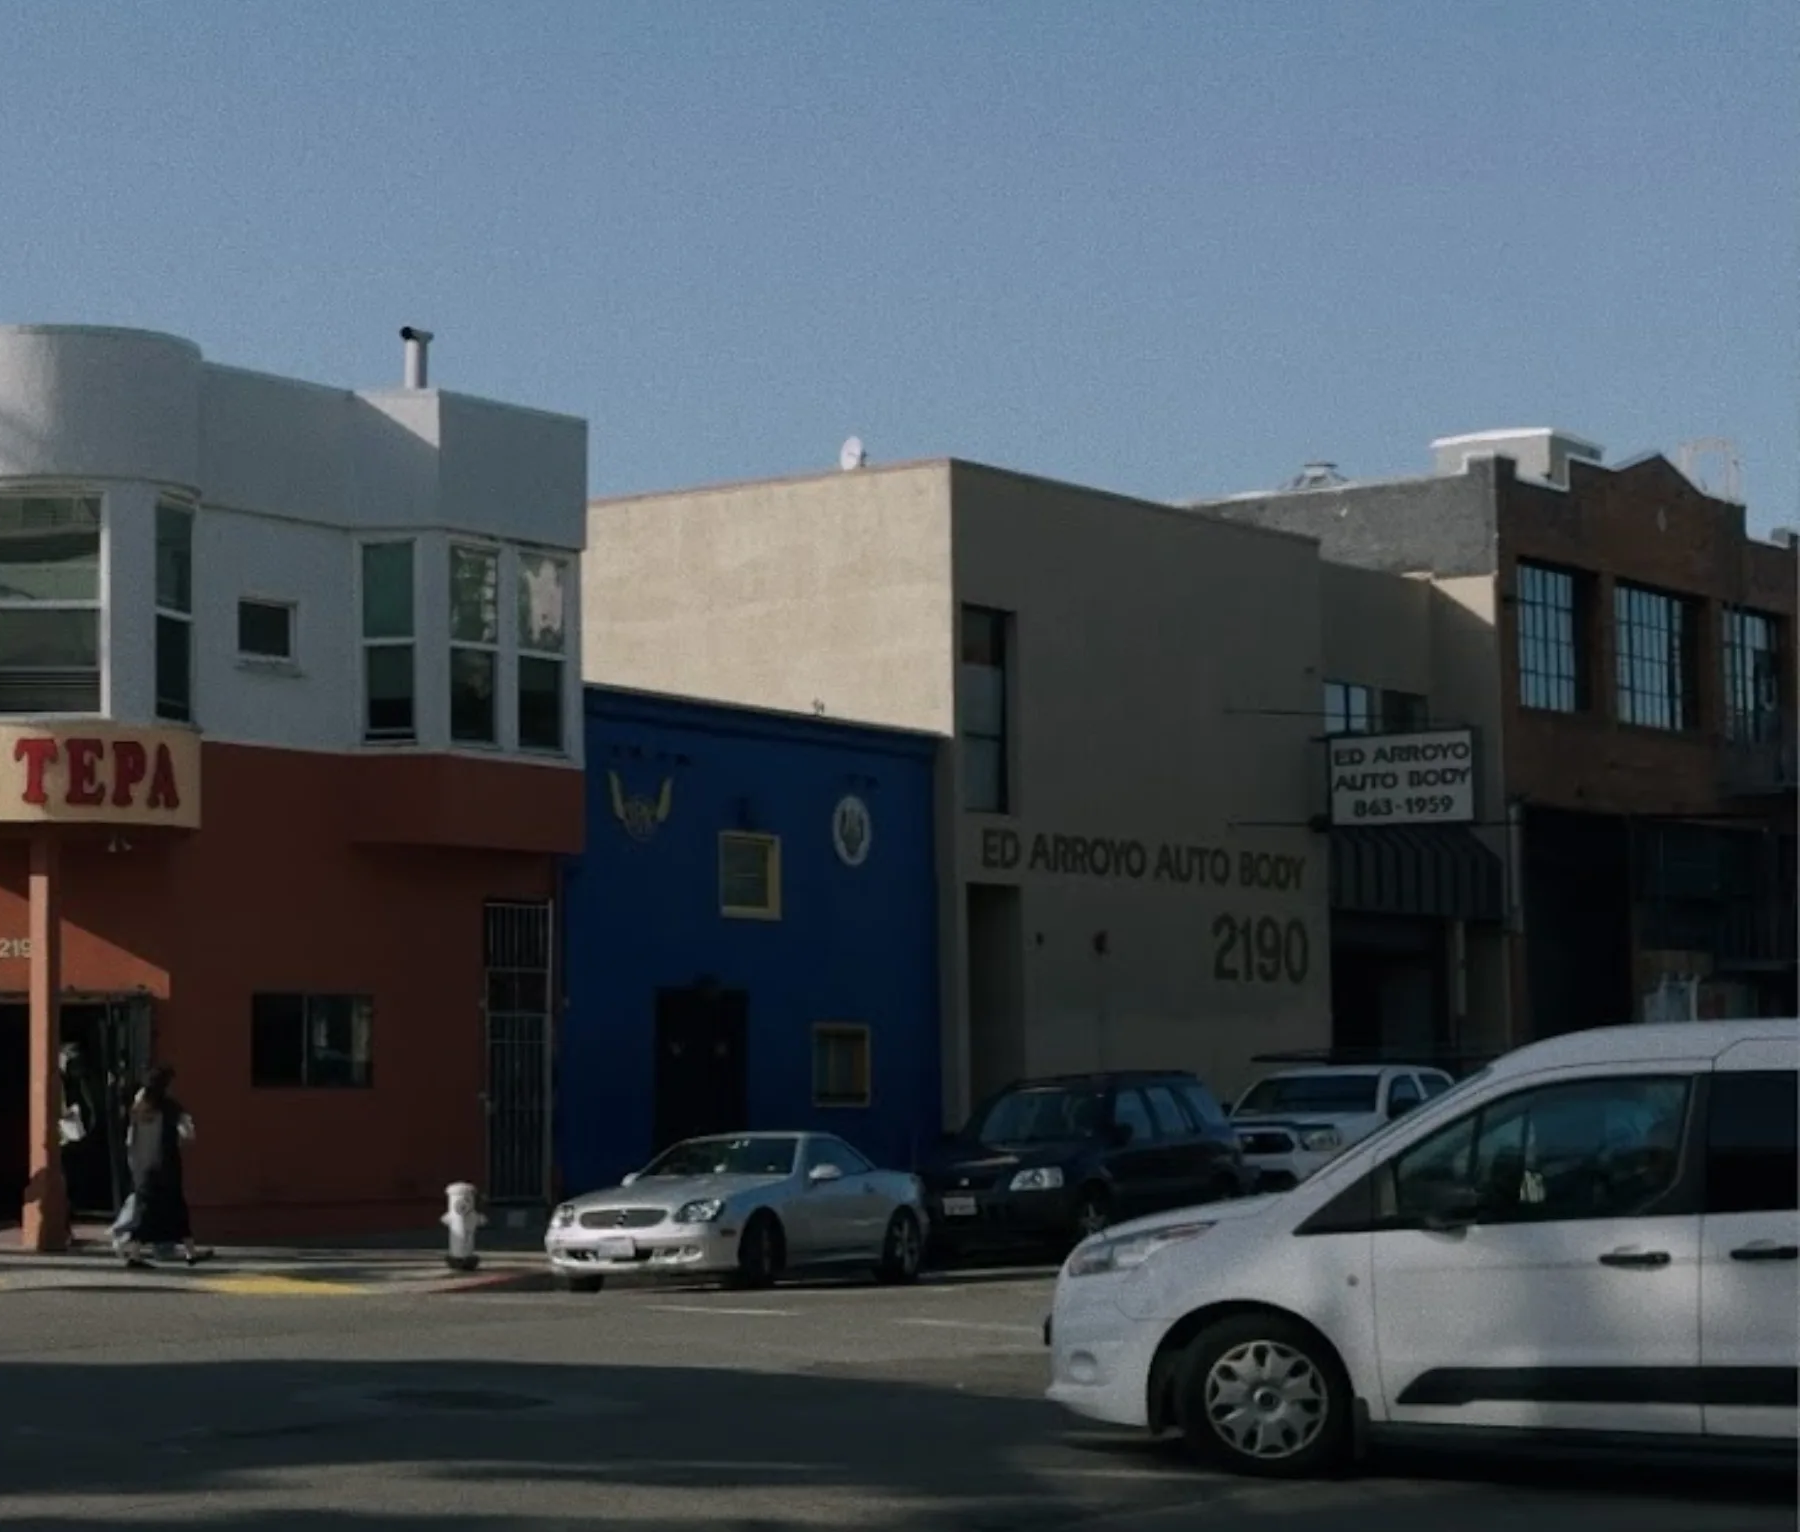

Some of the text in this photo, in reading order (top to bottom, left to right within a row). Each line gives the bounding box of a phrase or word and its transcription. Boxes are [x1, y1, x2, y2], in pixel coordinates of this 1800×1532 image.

[13, 738, 180, 809] TEPA
[1334, 741, 1469, 767] ED ARROYO
[1334, 767, 1470, 792] AUTO BODY
[1355, 796, 1454, 817] 863-1959
[982, 828, 1306, 890] ED ARROYO AUTO BODY
[1212, 912, 1310, 985] 2190
